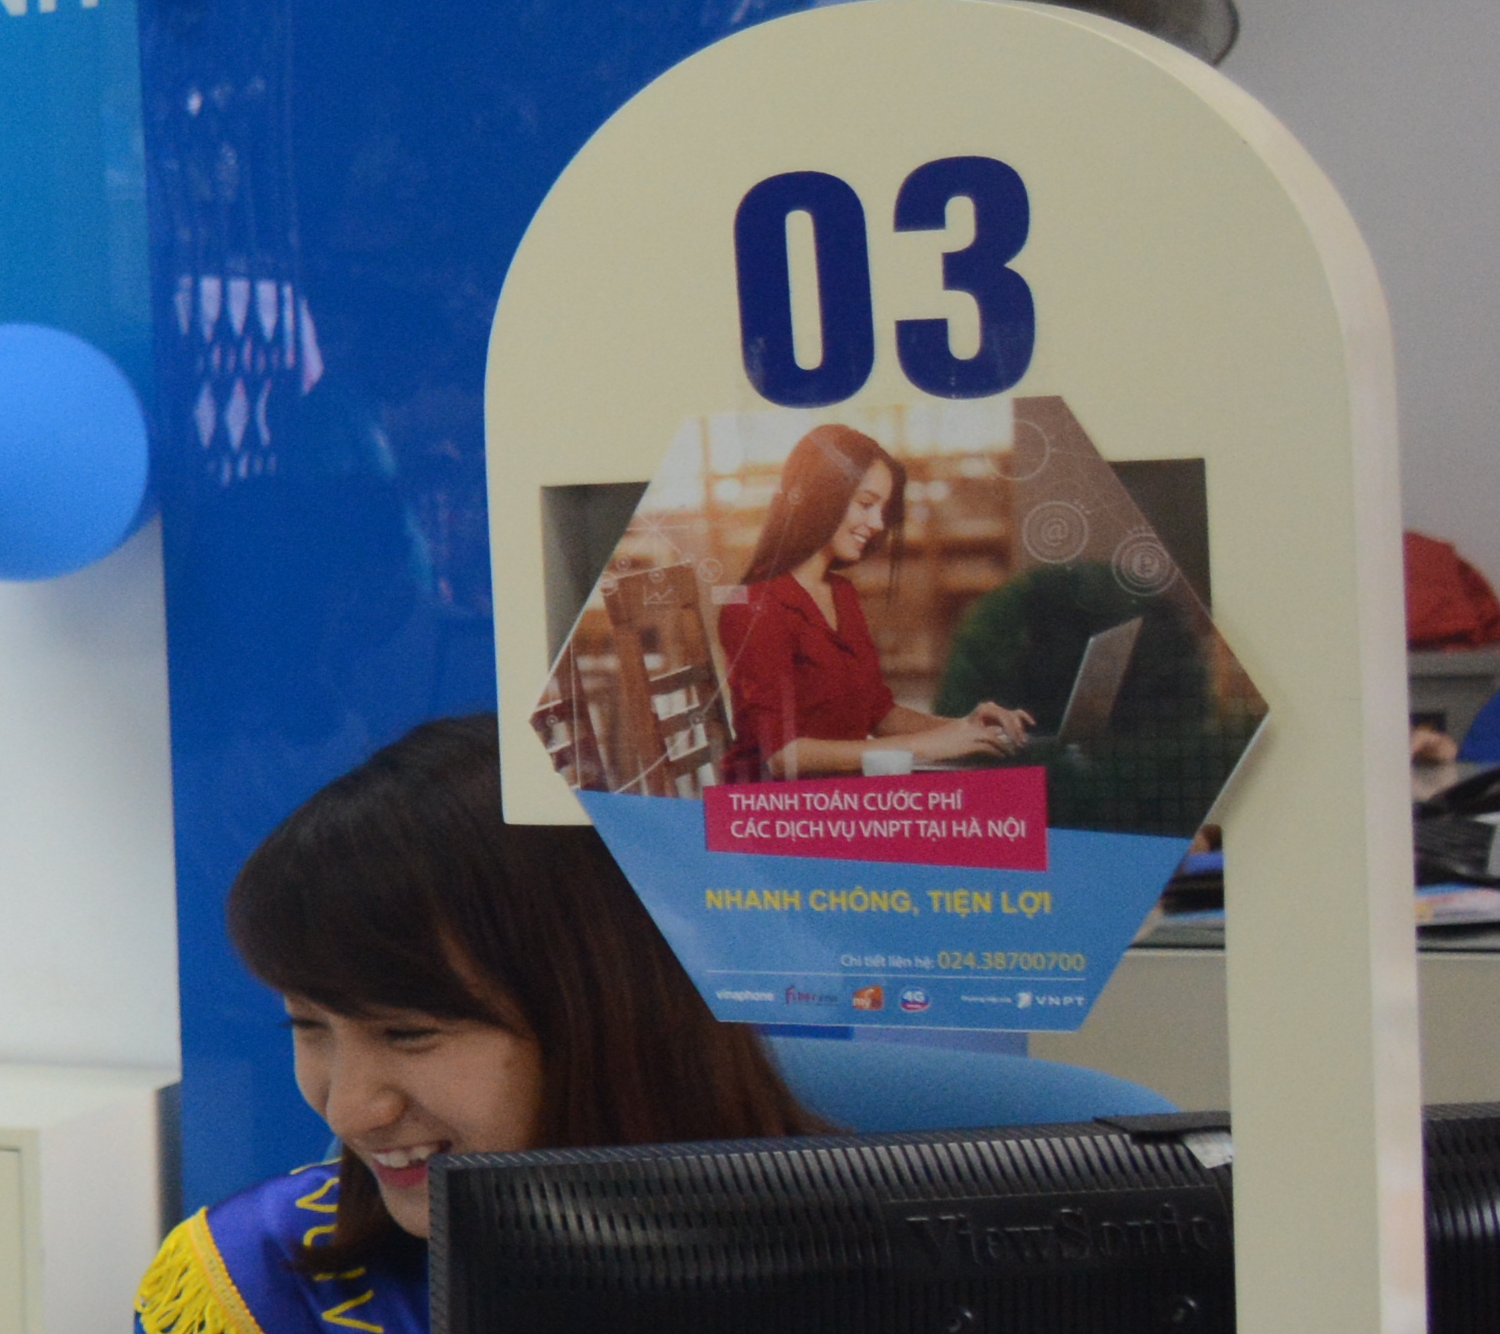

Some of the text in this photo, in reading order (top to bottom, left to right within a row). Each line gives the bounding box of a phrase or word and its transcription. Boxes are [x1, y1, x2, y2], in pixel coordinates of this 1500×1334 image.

[734, 154, 1037, 409] 03
[728, 788, 963, 812] THANH TOÁN CƯỚC PHÍ
[730, 816, 1026, 843] CÁC DỊCH VỤ VNPT TẠI HÀ NỘI
[705, 888, 801, 911] NHANH
[926, 887, 992, 918] TIỆN
[1001, 889, 1052, 919] LỢI
[937, 950, 1087, 972] 024.38700700
[1035, 995, 1086, 1007] VNPT
